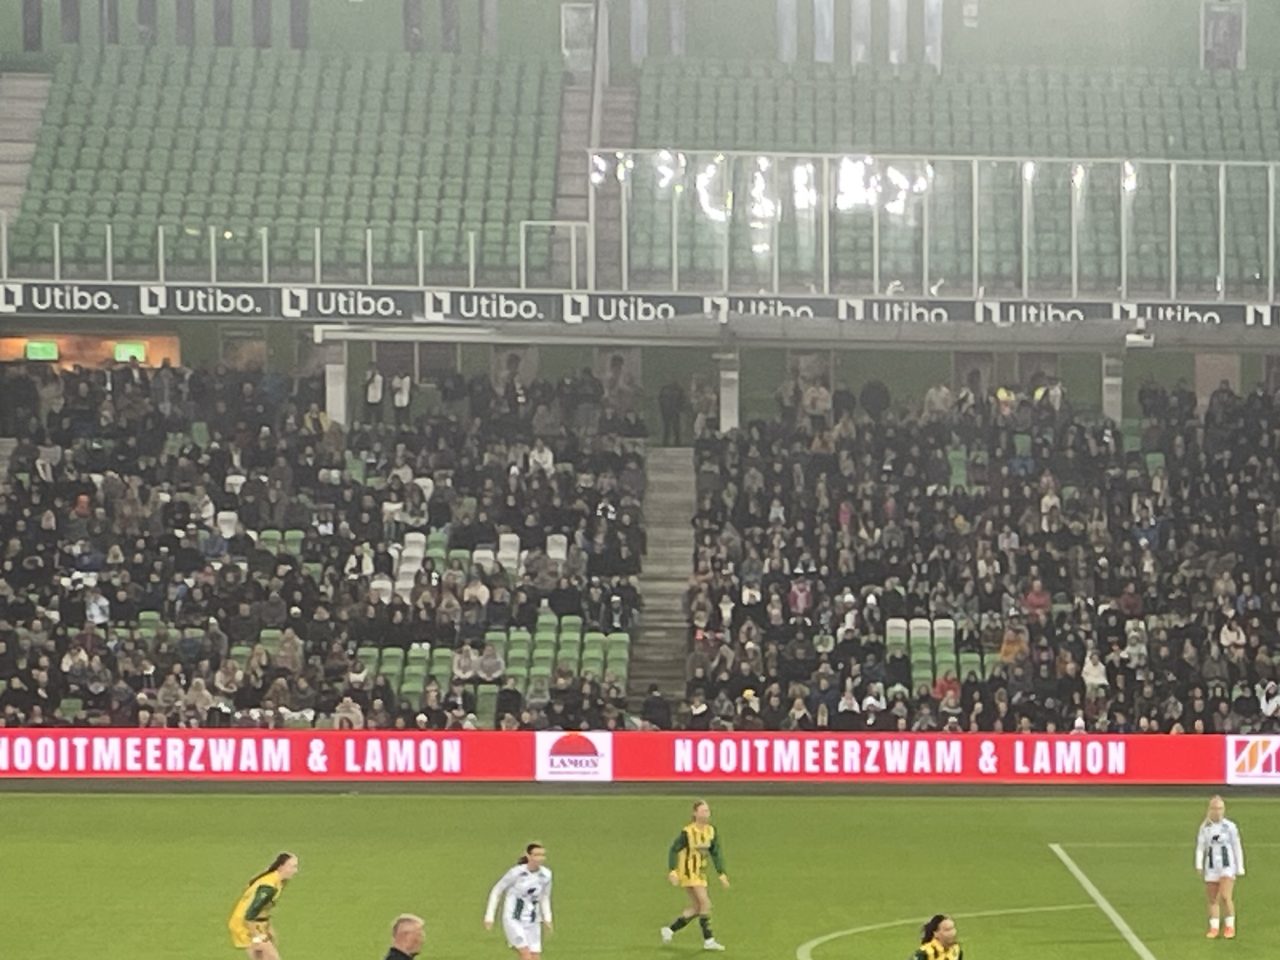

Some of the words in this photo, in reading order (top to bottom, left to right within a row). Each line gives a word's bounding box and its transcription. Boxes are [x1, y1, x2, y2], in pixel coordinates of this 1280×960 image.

[31, 285, 120, 311] Utibo.
[174, 287, 262, 314] Utibo.
[316, 290, 402, 317] Utibo.
[459, 294, 545, 319] Utibo.
[308, 739, 327, 771] &
[346, 739, 460, 772] LAMON
[675, 739, 961, 772] NOOITMEERZWAM
[979, 741, 997, 773] &
[1015, 741, 1125, 773] LAMON
